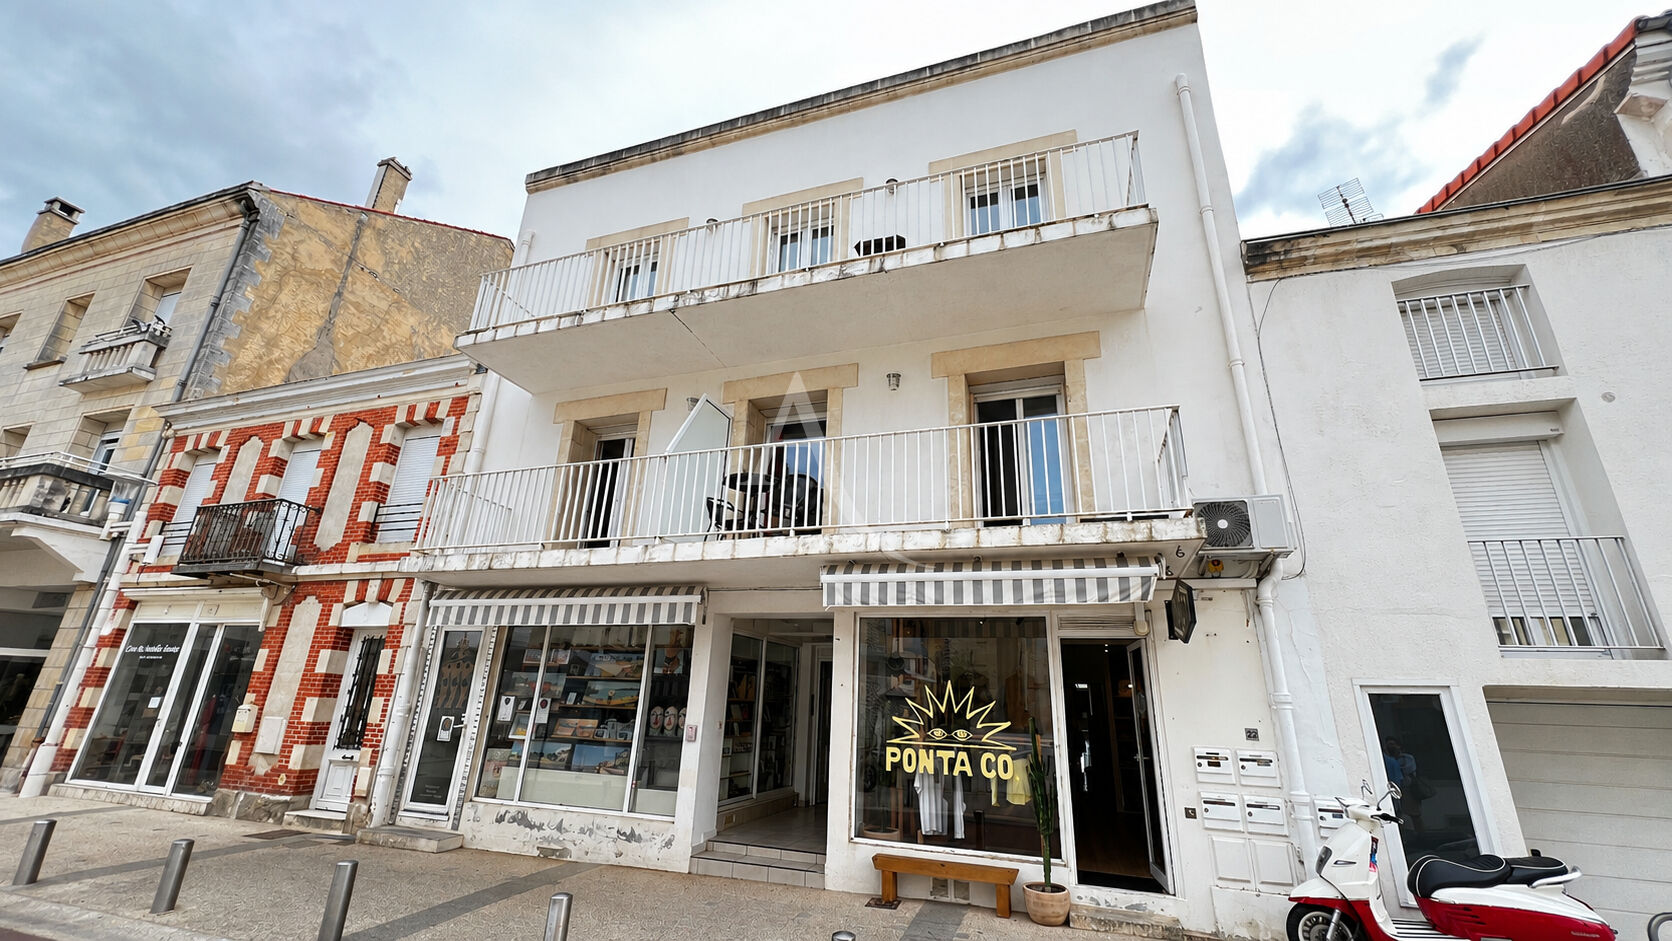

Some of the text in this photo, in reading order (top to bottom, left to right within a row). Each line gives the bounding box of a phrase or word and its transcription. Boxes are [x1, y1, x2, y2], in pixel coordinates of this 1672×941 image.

[1175, 545, 1185, 558] 6
[885, 746, 1014, 780] PONTA CO
